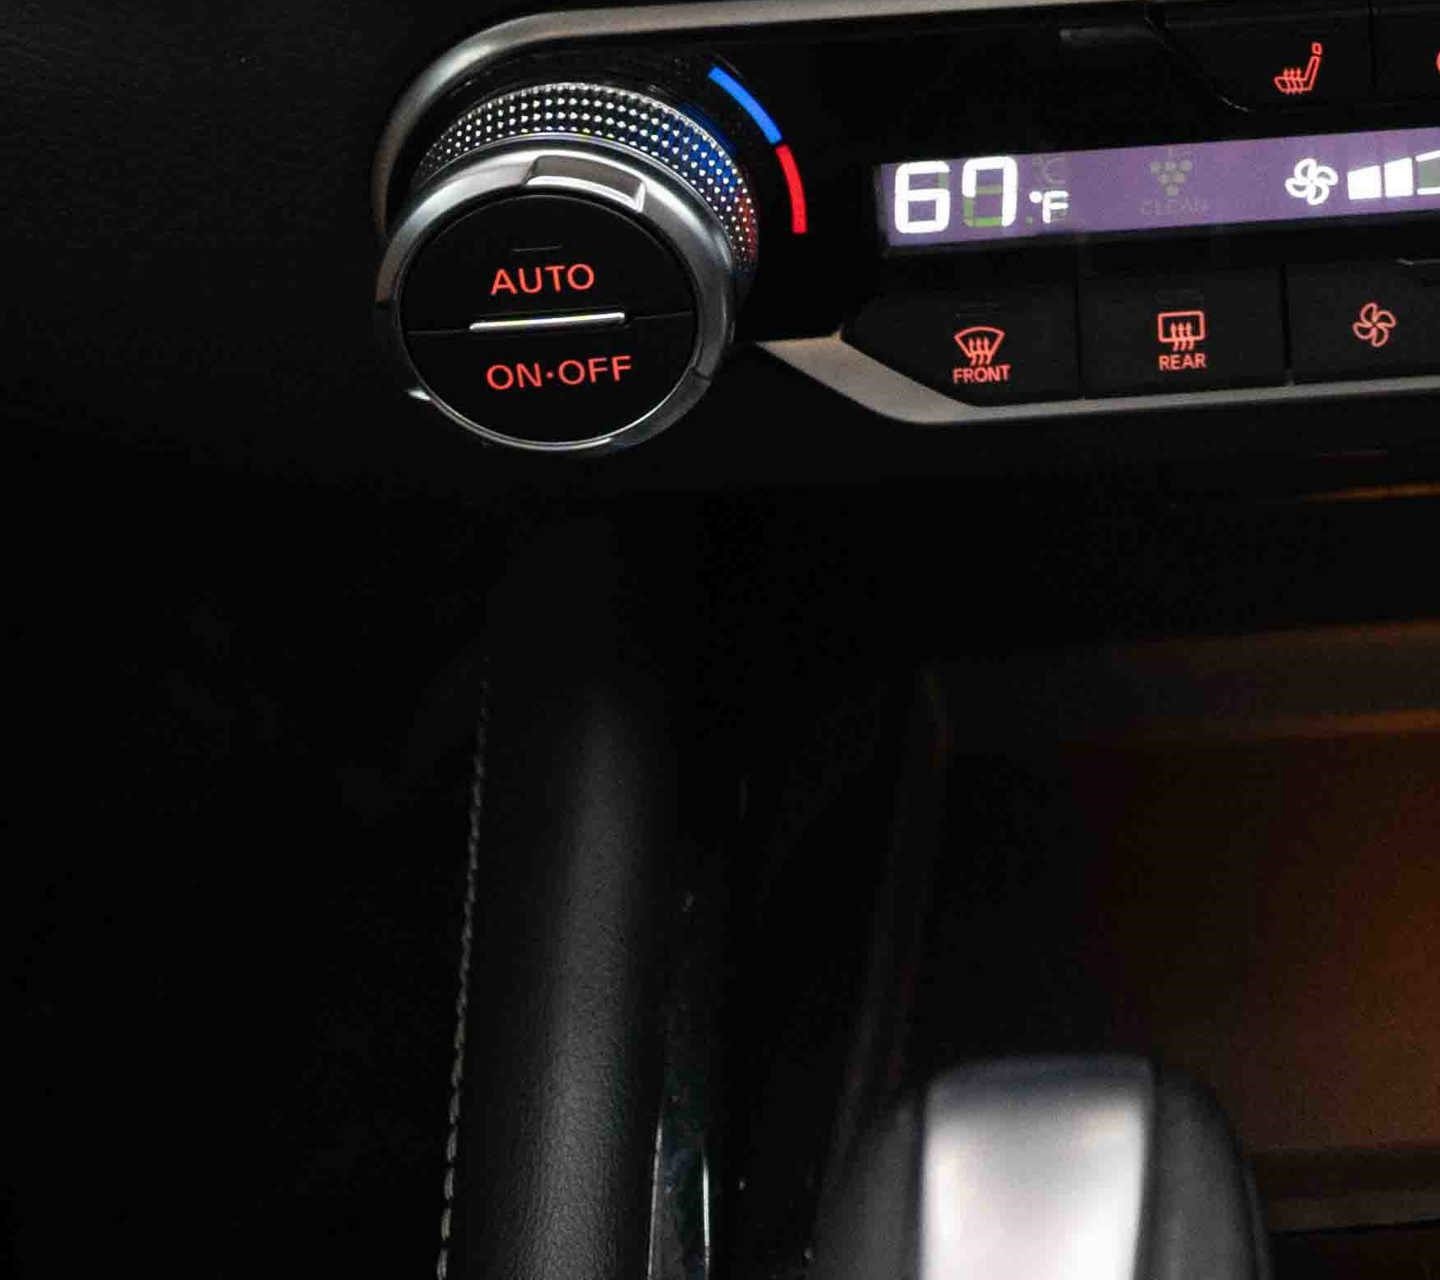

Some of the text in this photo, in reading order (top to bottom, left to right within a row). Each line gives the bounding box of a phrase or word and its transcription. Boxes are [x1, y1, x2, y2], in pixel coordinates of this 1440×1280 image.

[490, 263, 595, 295] AUTO
[1158, 351, 1206, 371] REAR
[953, 362, 1011, 383] FRONT
